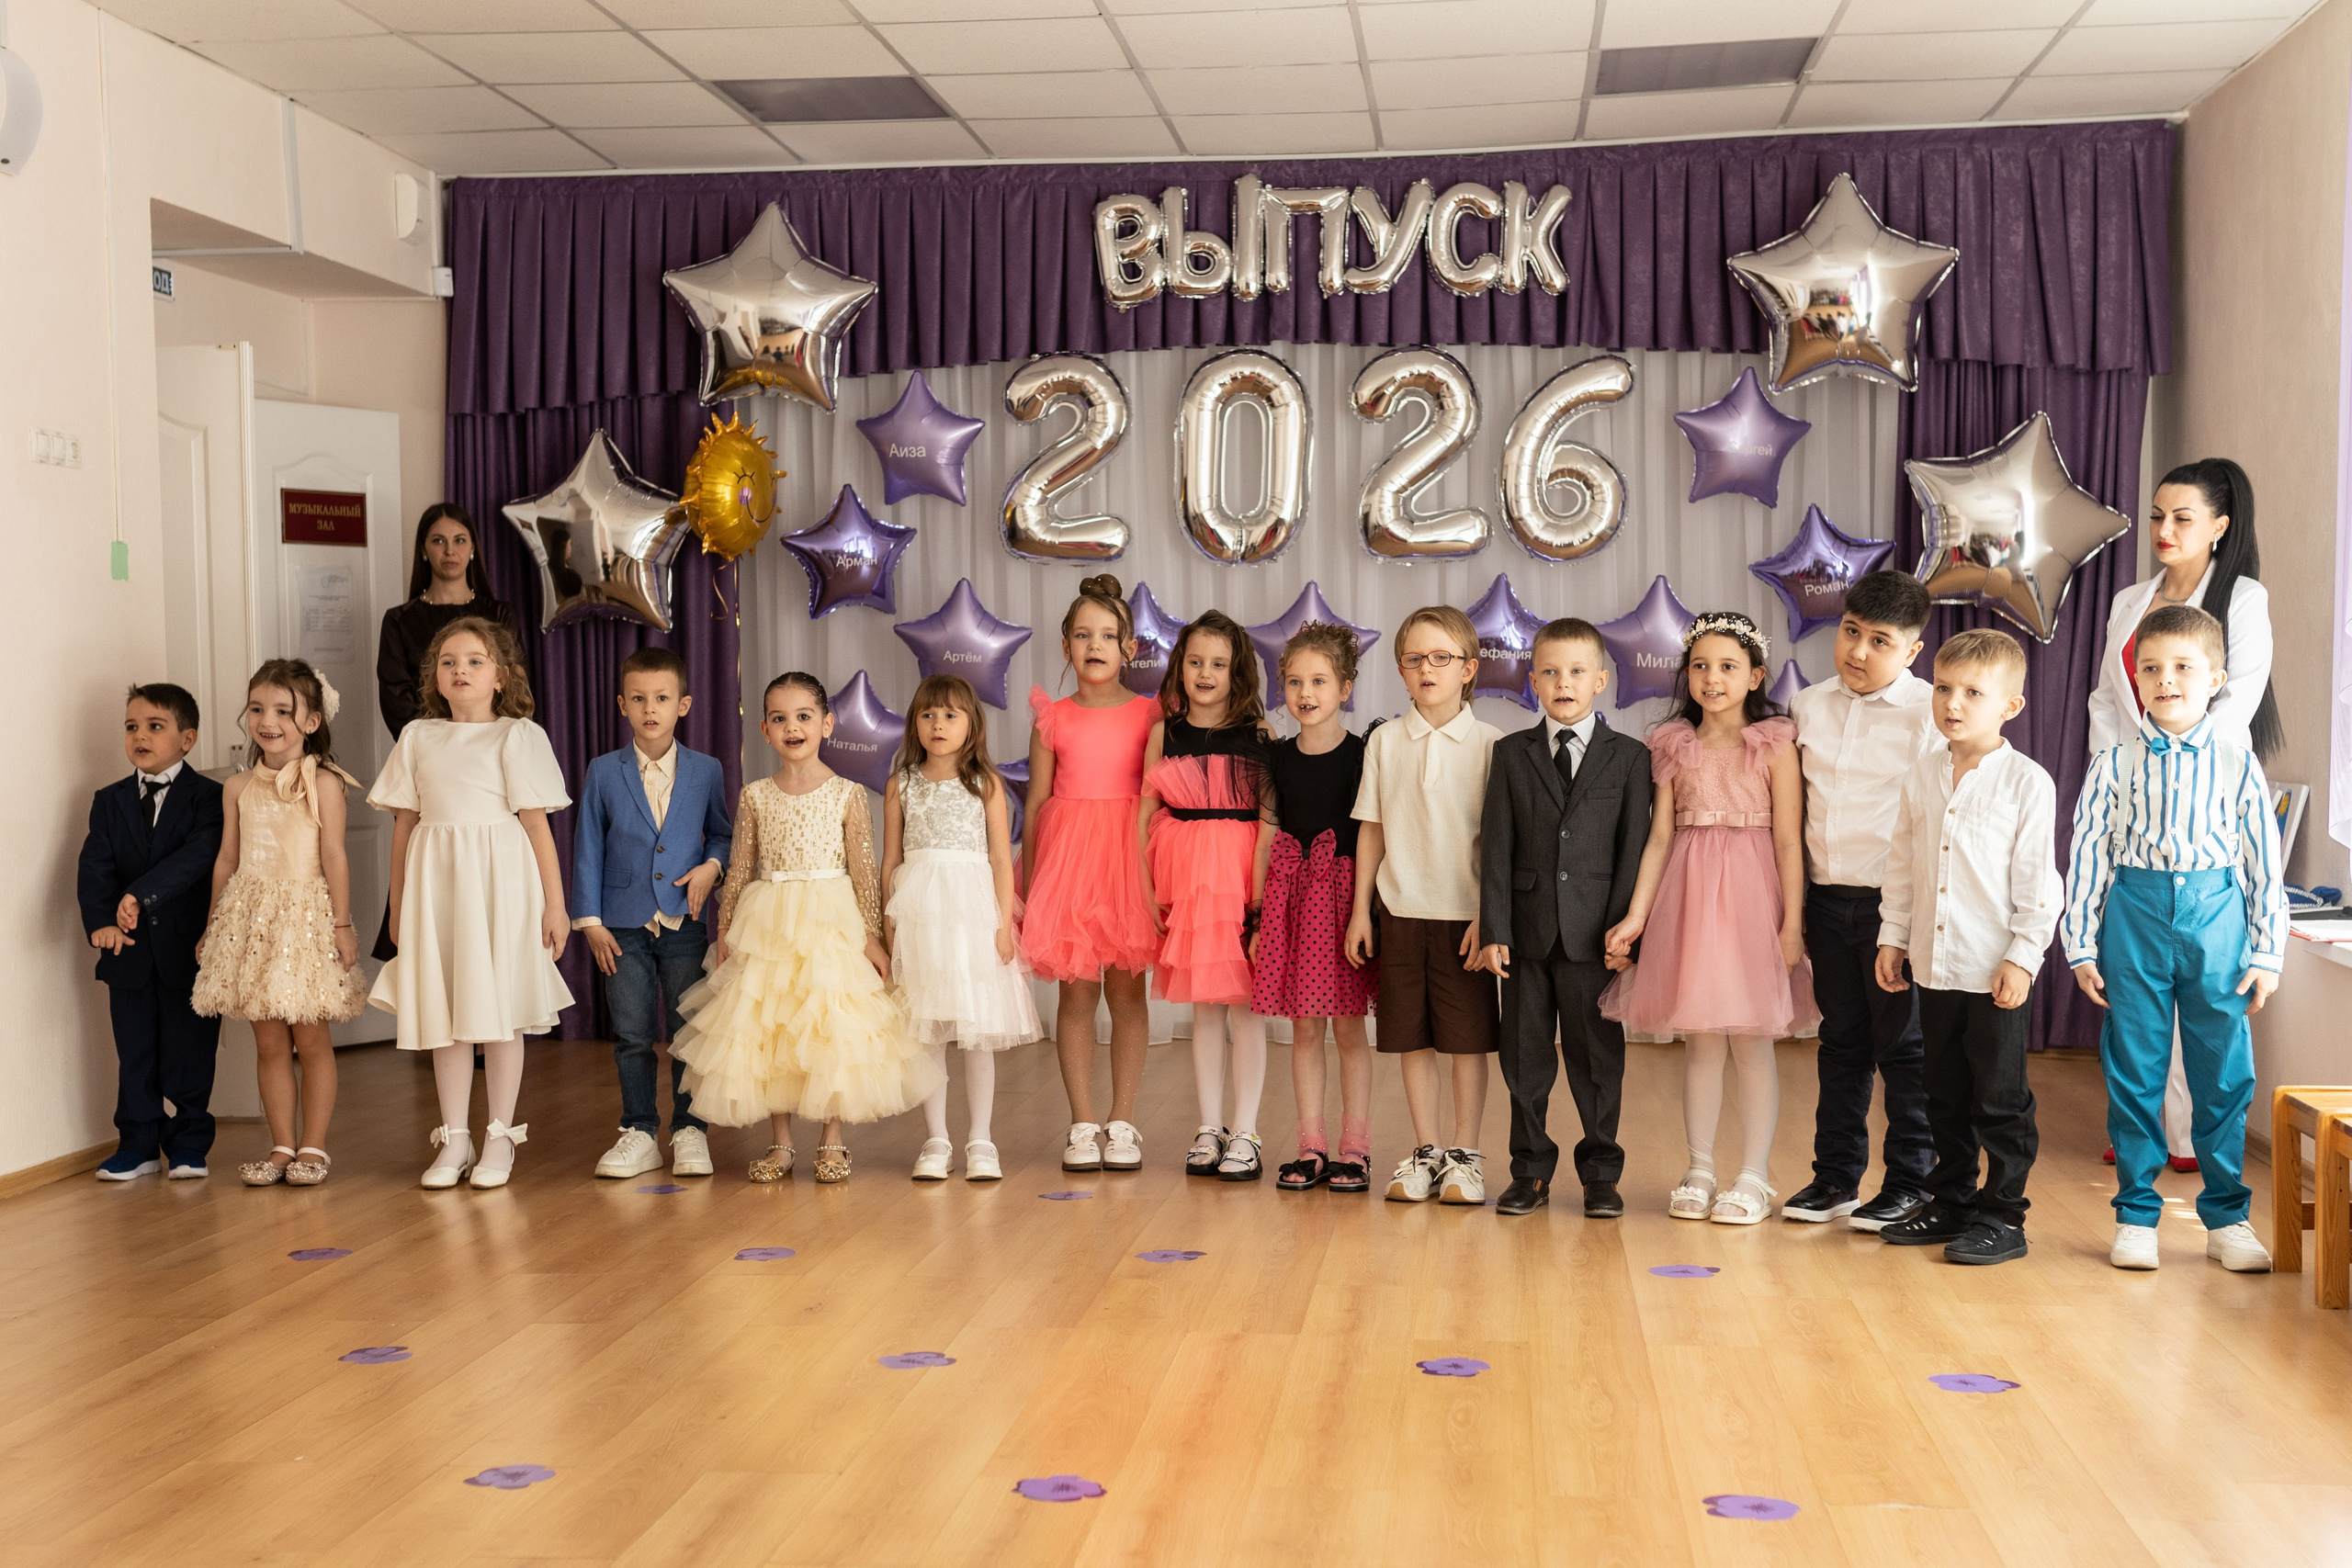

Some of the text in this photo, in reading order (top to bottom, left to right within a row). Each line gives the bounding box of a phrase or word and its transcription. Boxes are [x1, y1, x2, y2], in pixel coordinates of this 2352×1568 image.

[1093, 175, 1572, 310] ВЫПУСК
[888, 443, 926, 457] Аиза
[999, 345, 1635, 566] 2026
[288, 502, 361, 517] МУЗЫКАЛЬНЫЙ
[317, 519, 335, 531] ЗАЛ
[835, 555, 878, 570] Арман
[1804, 580, 1849, 597] Роман
[943, 649, 982, 664] Артём
[827, 737, 878, 752] Наталья
